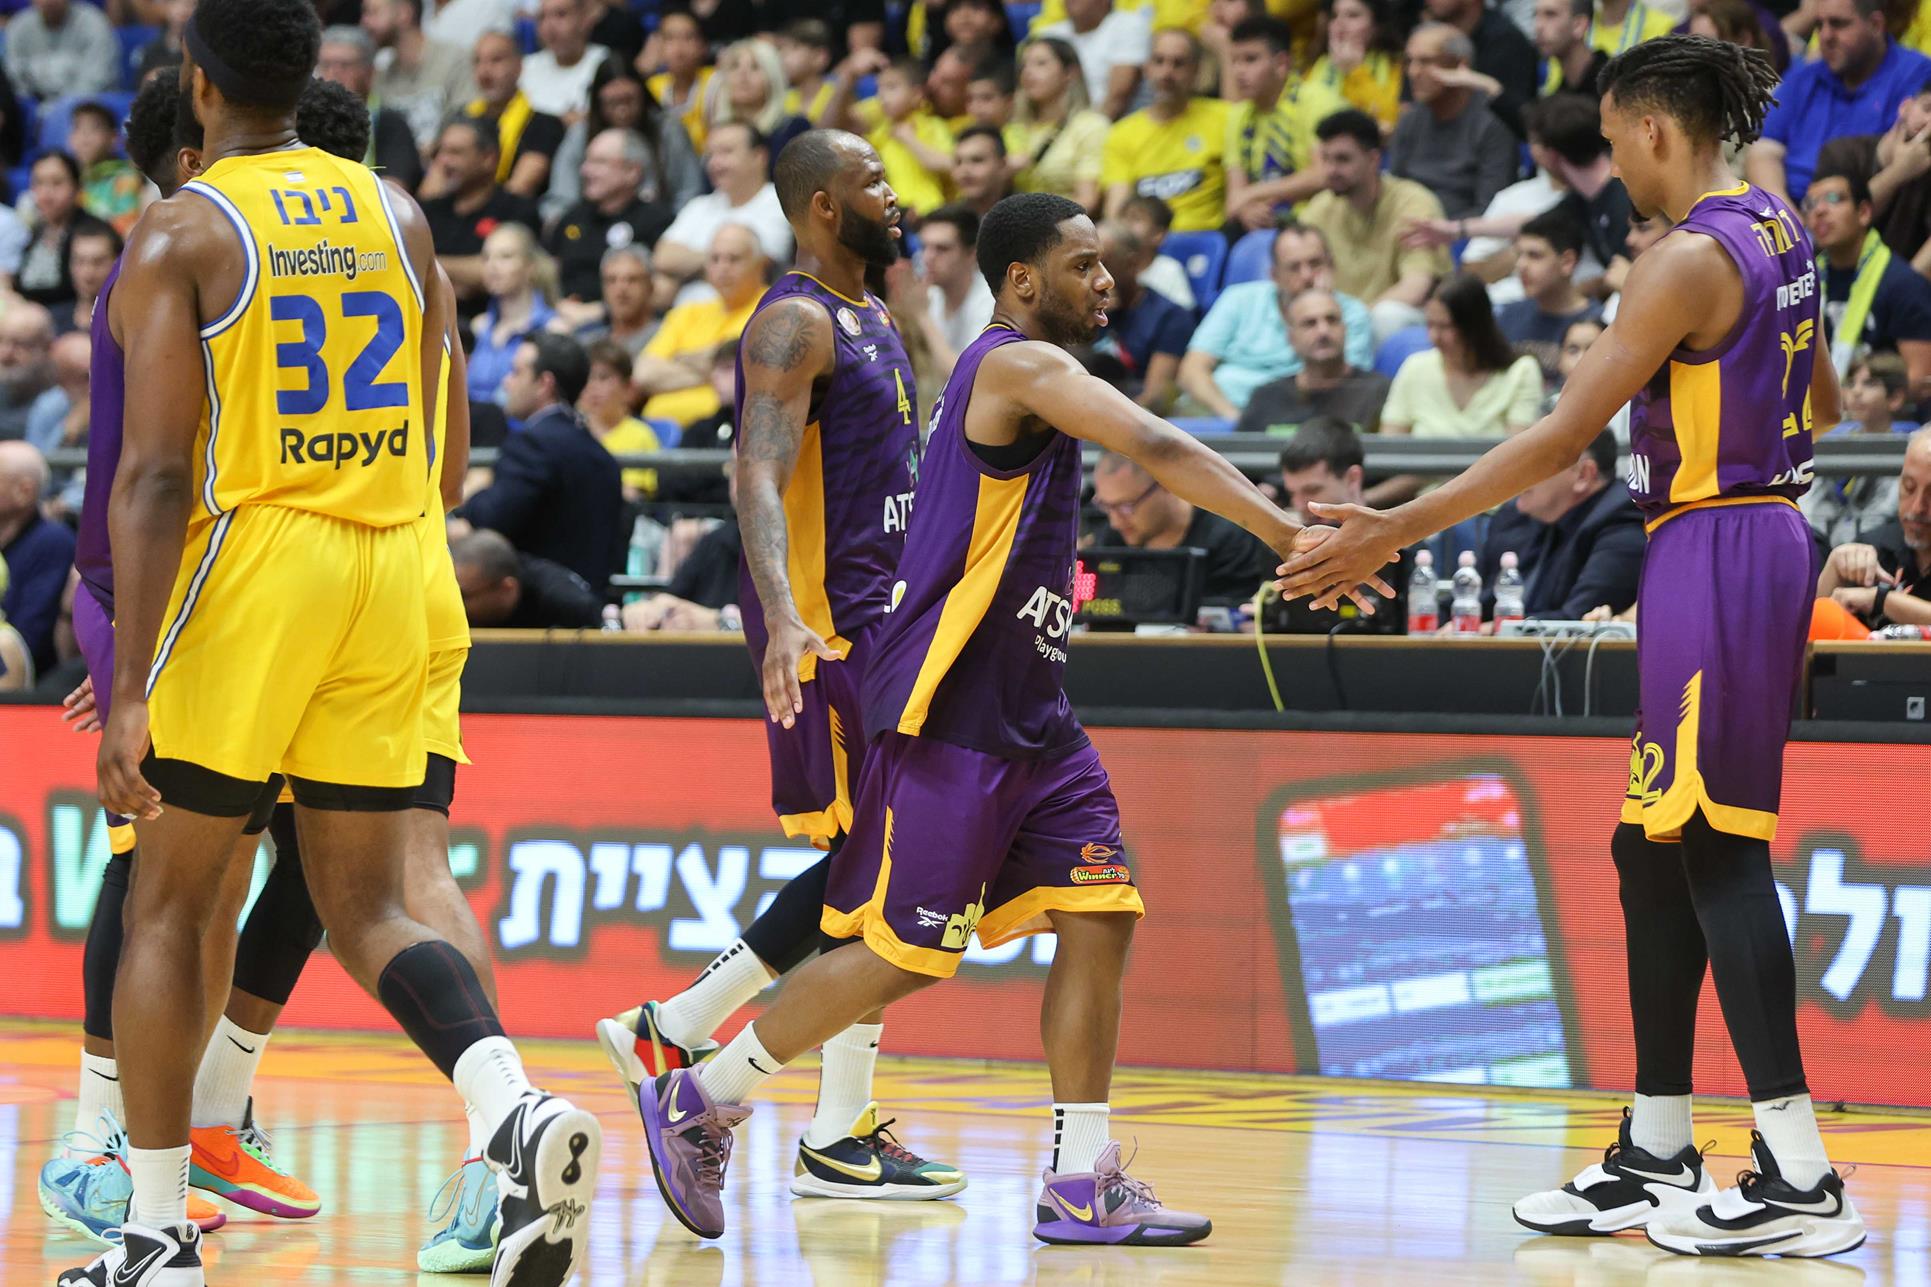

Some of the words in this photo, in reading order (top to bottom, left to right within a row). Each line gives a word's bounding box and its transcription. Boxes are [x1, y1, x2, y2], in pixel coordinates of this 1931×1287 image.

[269, 186, 359, 226] ניבו
[268, 239, 387, 281] Investing.com
[270, 290, 409, 415] 32
[894, 367, 912, 425] 4
[280, 419, 409, 470] Rapyd
[1077, 871, 1117, 881] Winner
[916, 906, 949, 922] Reebok
